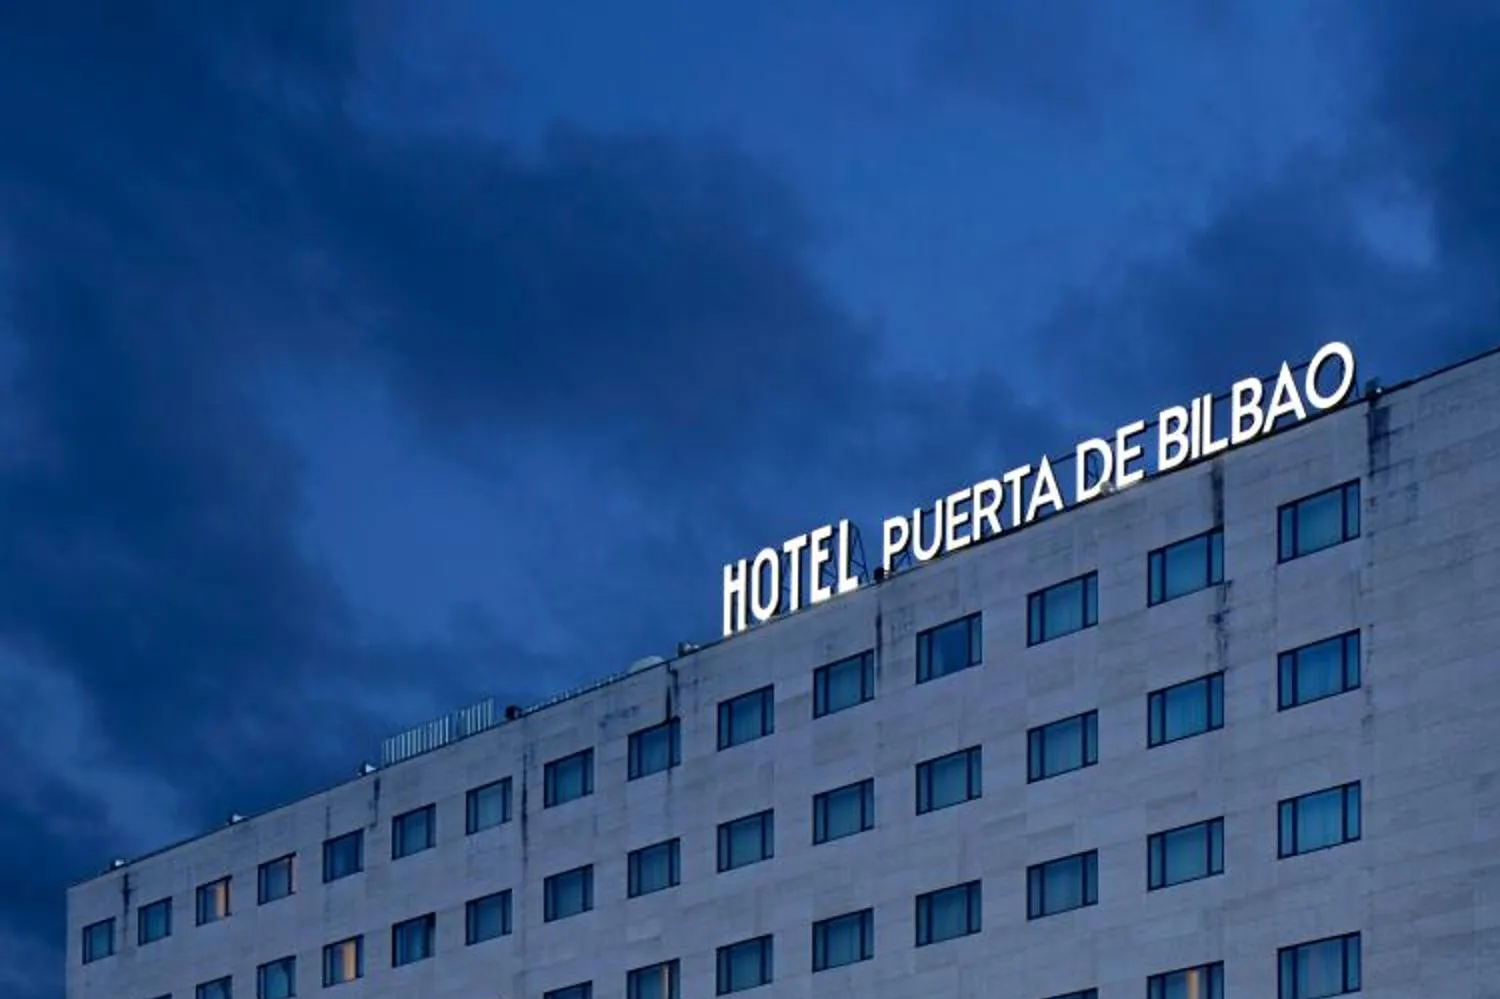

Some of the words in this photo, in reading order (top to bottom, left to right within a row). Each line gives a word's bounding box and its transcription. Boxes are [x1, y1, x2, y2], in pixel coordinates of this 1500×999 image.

[722, 519, 859, 638] HOTEL
[882, 455, 1064, 572] PUERTA
[1075, 420, 1145, 503] DE
[1157, 341, 1355, 472] BILBAO
